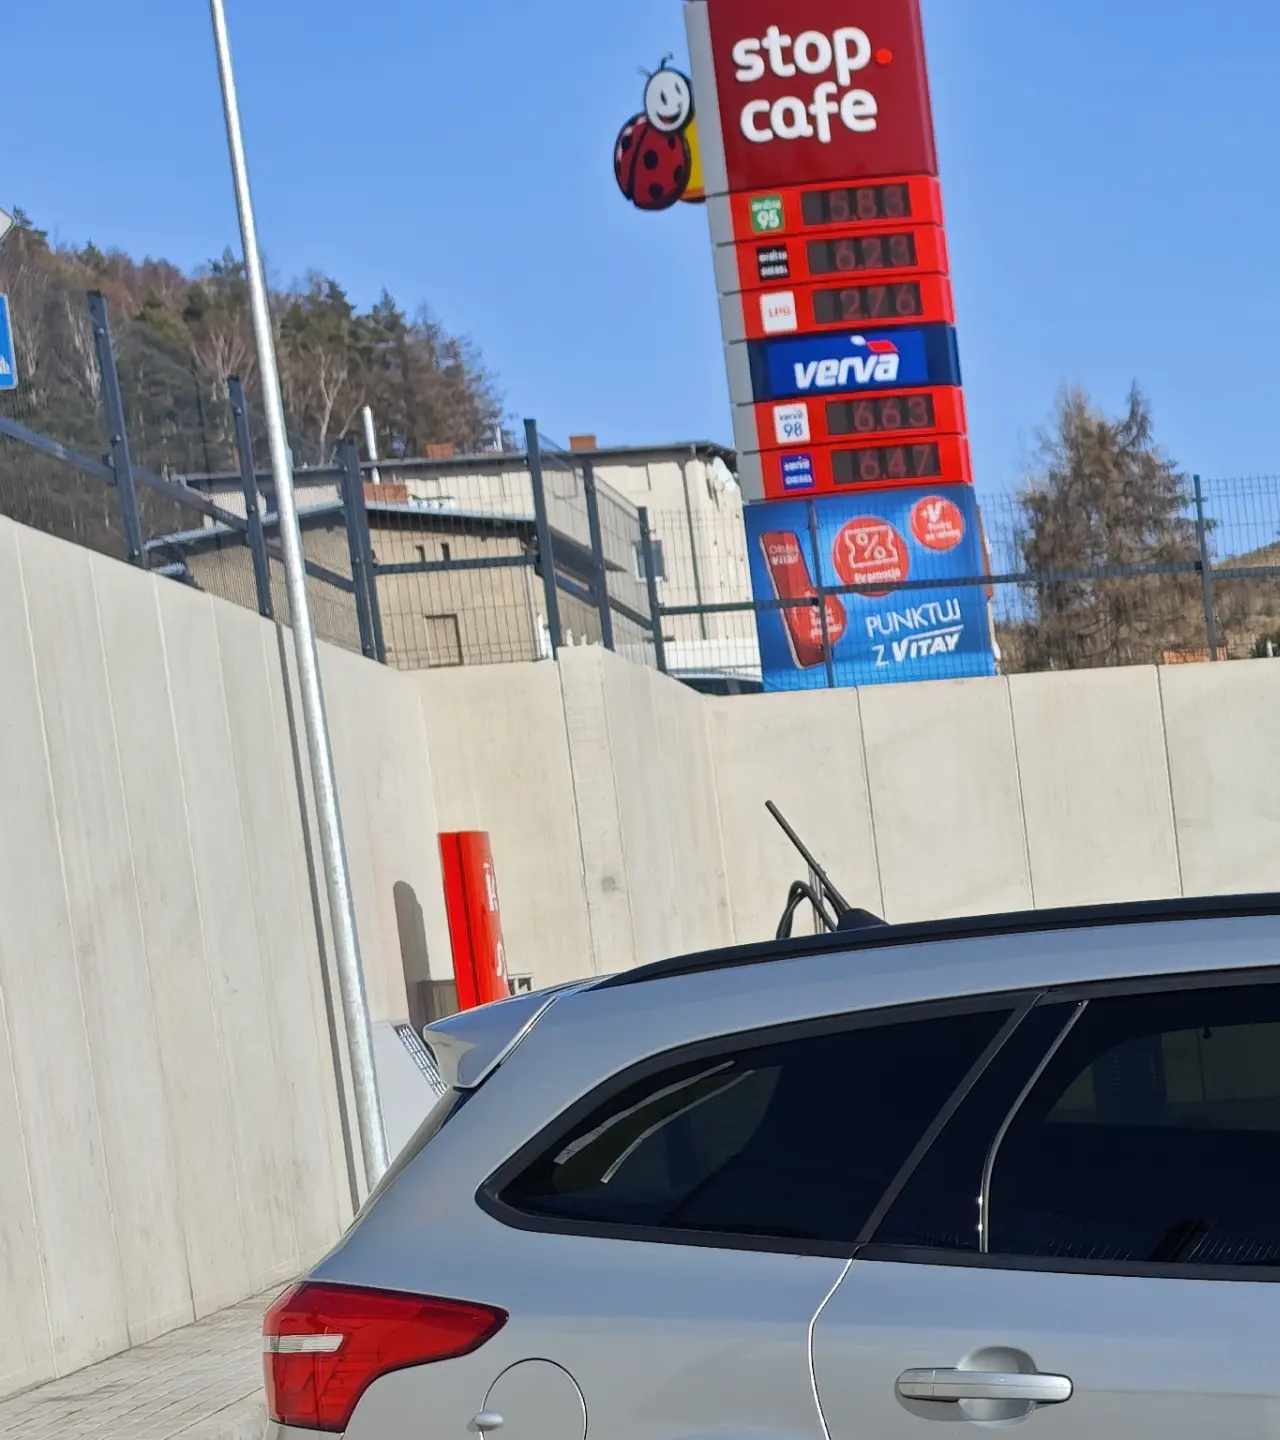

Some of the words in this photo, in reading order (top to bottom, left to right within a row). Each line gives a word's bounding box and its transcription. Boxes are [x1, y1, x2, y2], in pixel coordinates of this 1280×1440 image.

[739, 81, 879, 143] cafe
[756, 208, 781, 230] 95
[793, 353, 901, 390] verva
[783, 422, 804, 438] 98
[864, 598, 962, 638] PUNKTUJ
[891, 627, 963, 663] VITAY
